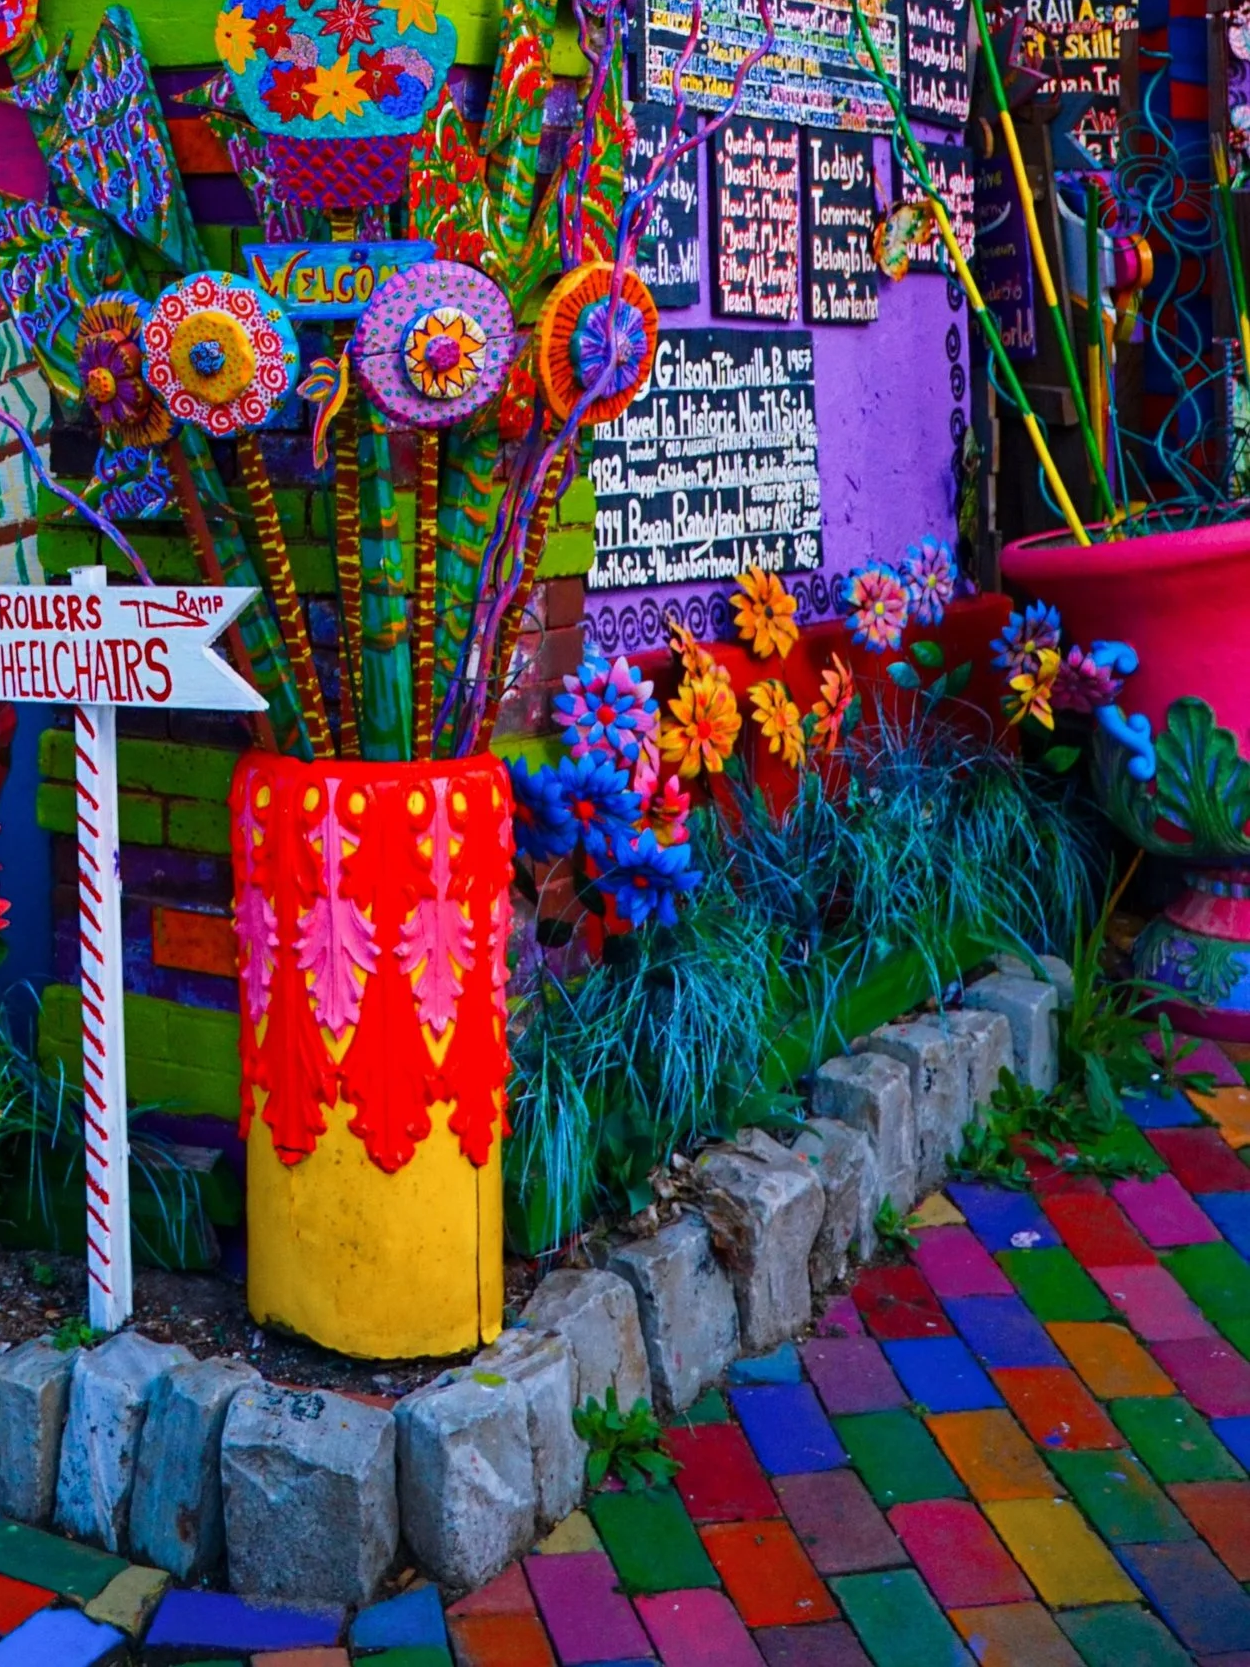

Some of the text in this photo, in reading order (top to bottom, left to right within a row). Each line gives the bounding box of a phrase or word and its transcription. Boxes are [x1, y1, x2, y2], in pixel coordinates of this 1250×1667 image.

[906, 0, 929, 28] Who
[929, 6, 956, 35] Makes
[908, 40, 967, 77] Everybody Feel
[631, 138, 654, 166] you
[724, 126, 766, 158] Question
[725, 157, 751, 186] Does
[721, 189, 743, 217] How
[678, 239, 700, 284] Will
[813, 235, 850, 279] Belong
[848, 232, 860, 273] To
[721, 283, 752, 313] Teach
[812, 282, 828, 320] Be
[828, 282, 850, 319] Your
[786, 348, 812, 372] 1957
[659, 396, 675, 438] To
[678, 393, 736, 436] Historic
[672, 488, 744, 560] Randyland
[656, 539, 738, 584] Neighborhood
[176, 590, 224, 615] RAMP
